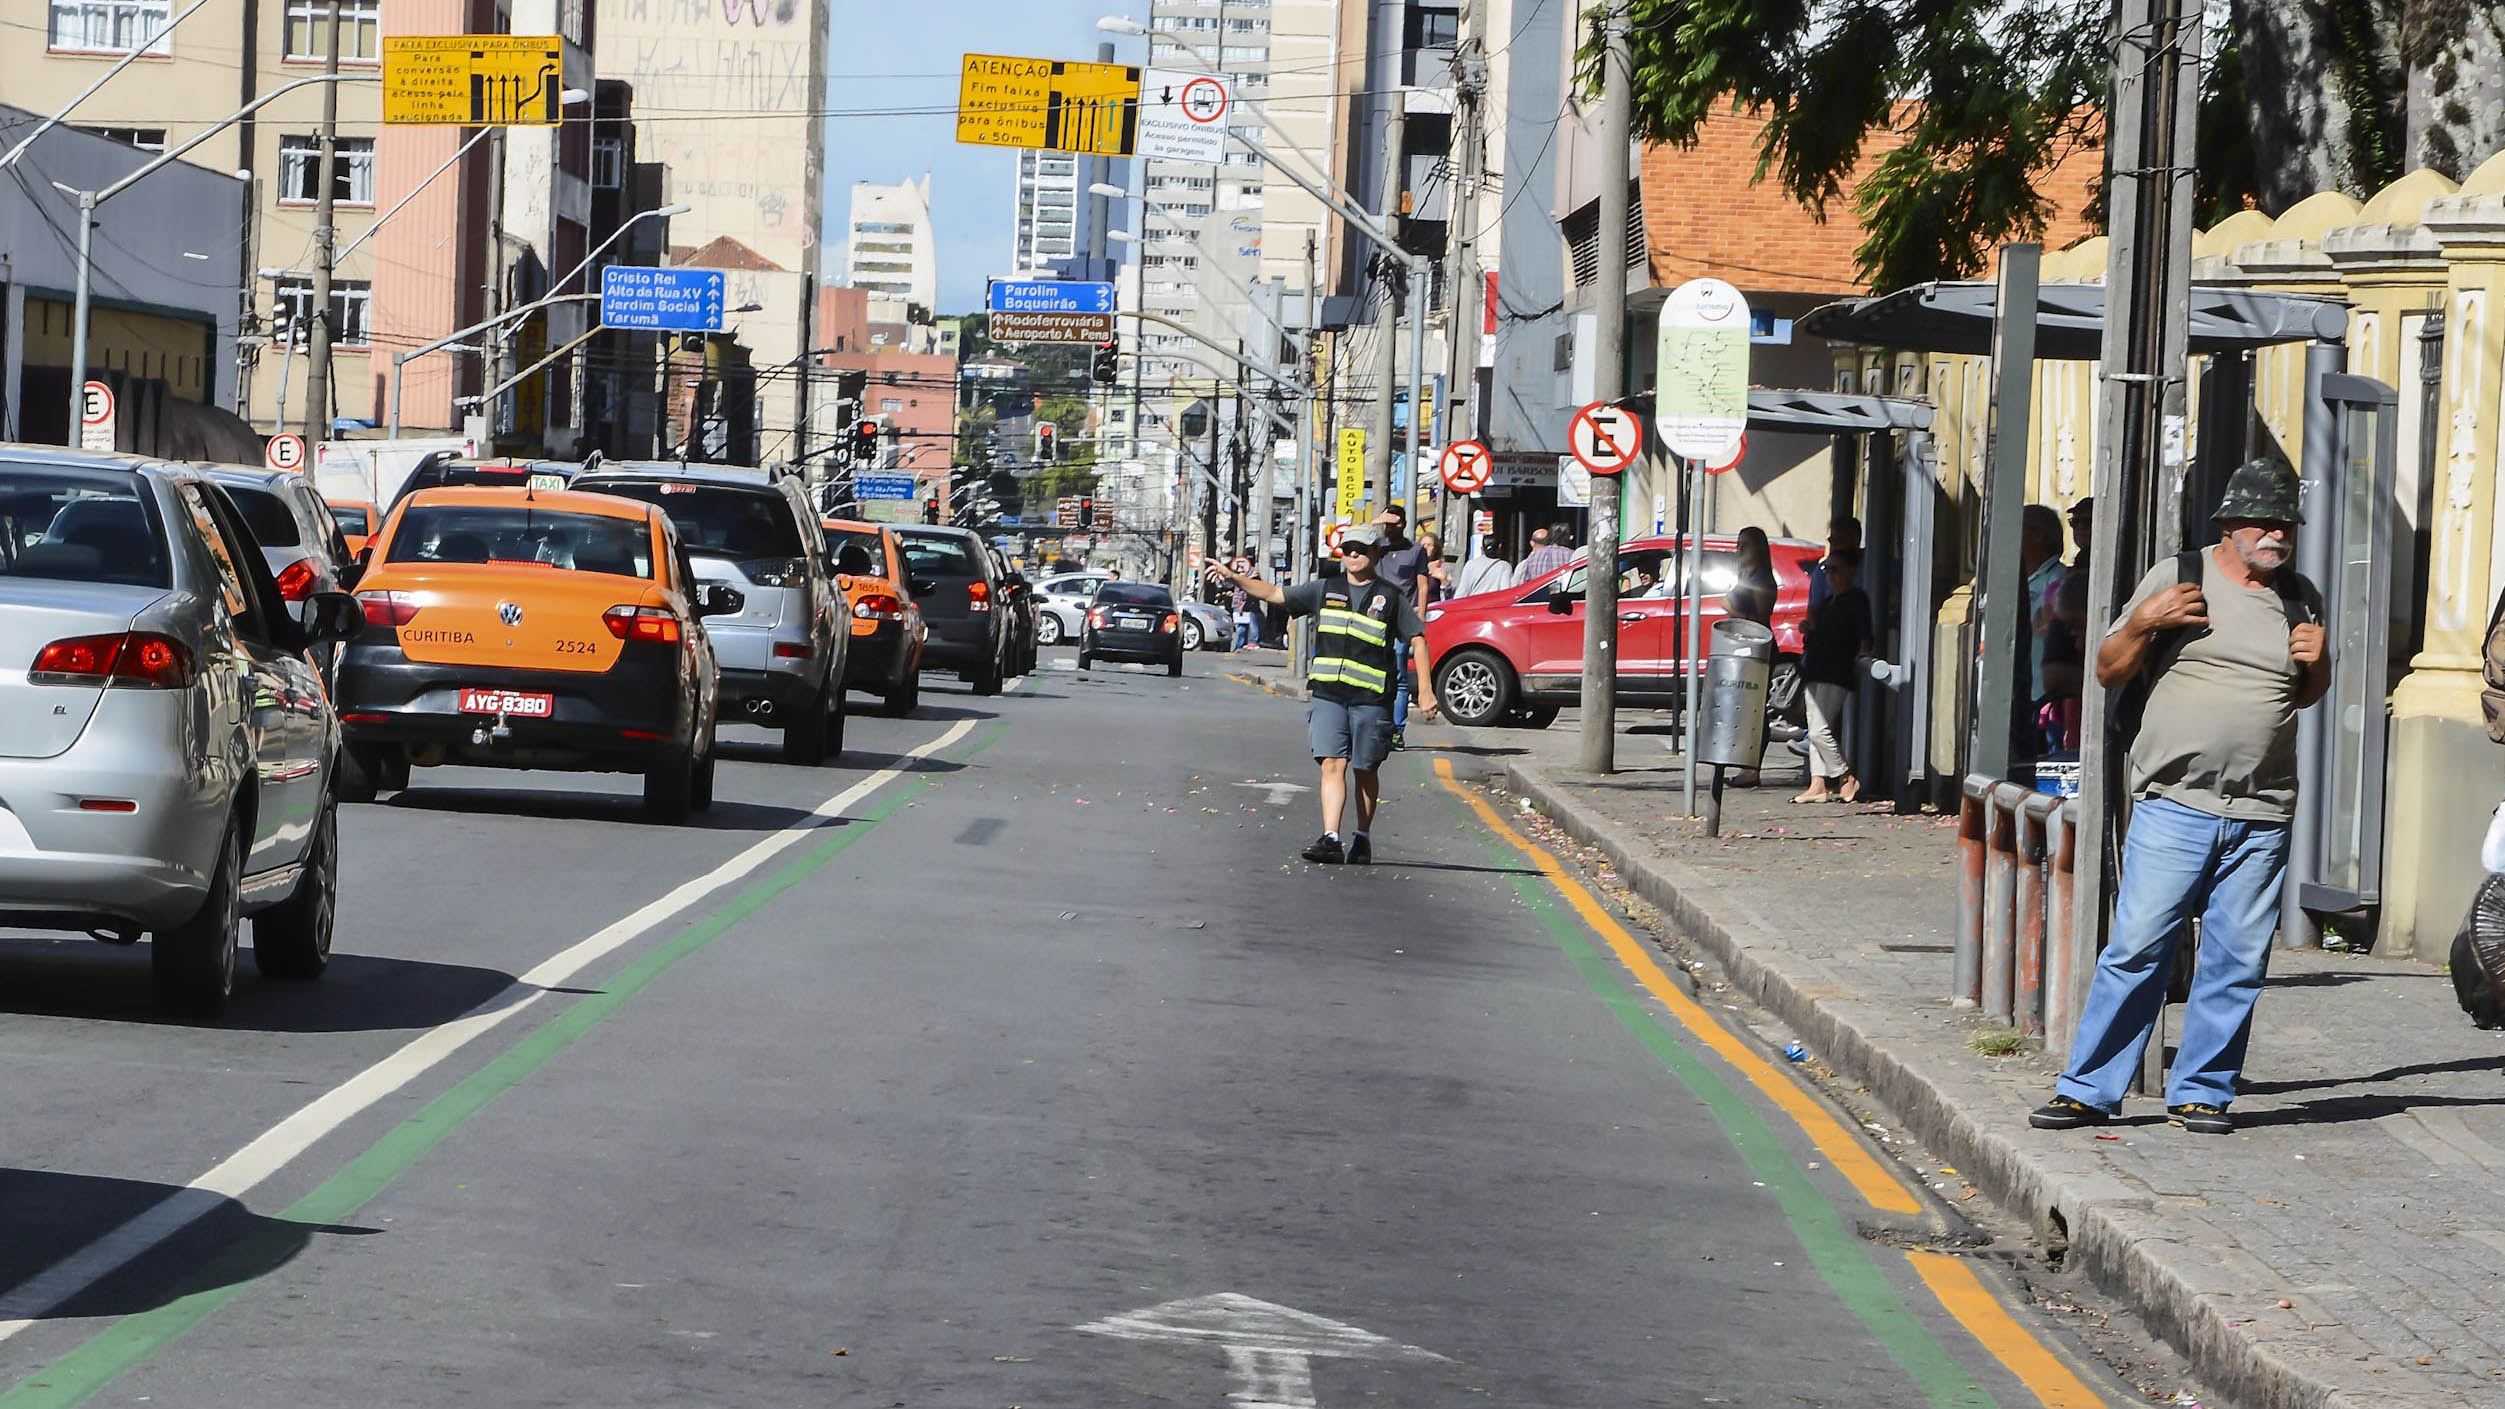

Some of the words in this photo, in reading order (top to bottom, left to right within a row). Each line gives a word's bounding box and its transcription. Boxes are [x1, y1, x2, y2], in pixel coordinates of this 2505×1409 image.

[425, 41, 479, 49] EXCLUSIVA
[483, 41, 509, 49] PARA
[414, 54, 441, 62] Para
[396, 66, 460, 74] conversão
[392, 90, 437, 98] acesso
[439, 90, 464, 99] pela
[971, 82, 997, 94] Fim
[1004, 84, 1041, 97] faixa
[412, 102, 444, 110] linha
[968, 99, 1039, 112] exclusiva
[959, 115, 991, 126] para
[997, 115, 1046, 129] ônibus
[1141, 119, 1190, 130] EXCLUSIVO
[993, 133, 1023, 144] 50m
[1144, 131, 1176, 140] Acesso
[1177, 135, 1217, 146] permitido
[607, 271, 651, 285] Cristo
[653, 273, 676, 285] Rei
[607, 285, 634, 297] Alto
[636, 286, 653, 298] da
[655, 287, 681, 299] Rua
[682, 288, 702, 300] XV
[1005, 285, 1058, 297] Parolim
[607, 299, 655, 311] Jardim
[657, 300, 700, 313] Social
[1005, 297, 1077, 311] Boqueirão
[607, 312, 659, 326] Tarumã
[1005, 314, 1104, 328] Rodoferroviária
[1004, 327, 1062, 341] Aeroporto
[1063, 328, 1077, 340] A.
[1080, 329, 1109, 341] Pena
[280, 441, 291, 461] E
[1347, 432, 1357, 463] AUTO
[533, 477, 561, 490] TAXI
[1345, 467, 1355, 515] ESCOLA
[403, 629, 475, 644] CURITIBA
[555, 640, 597, 654] 2524
